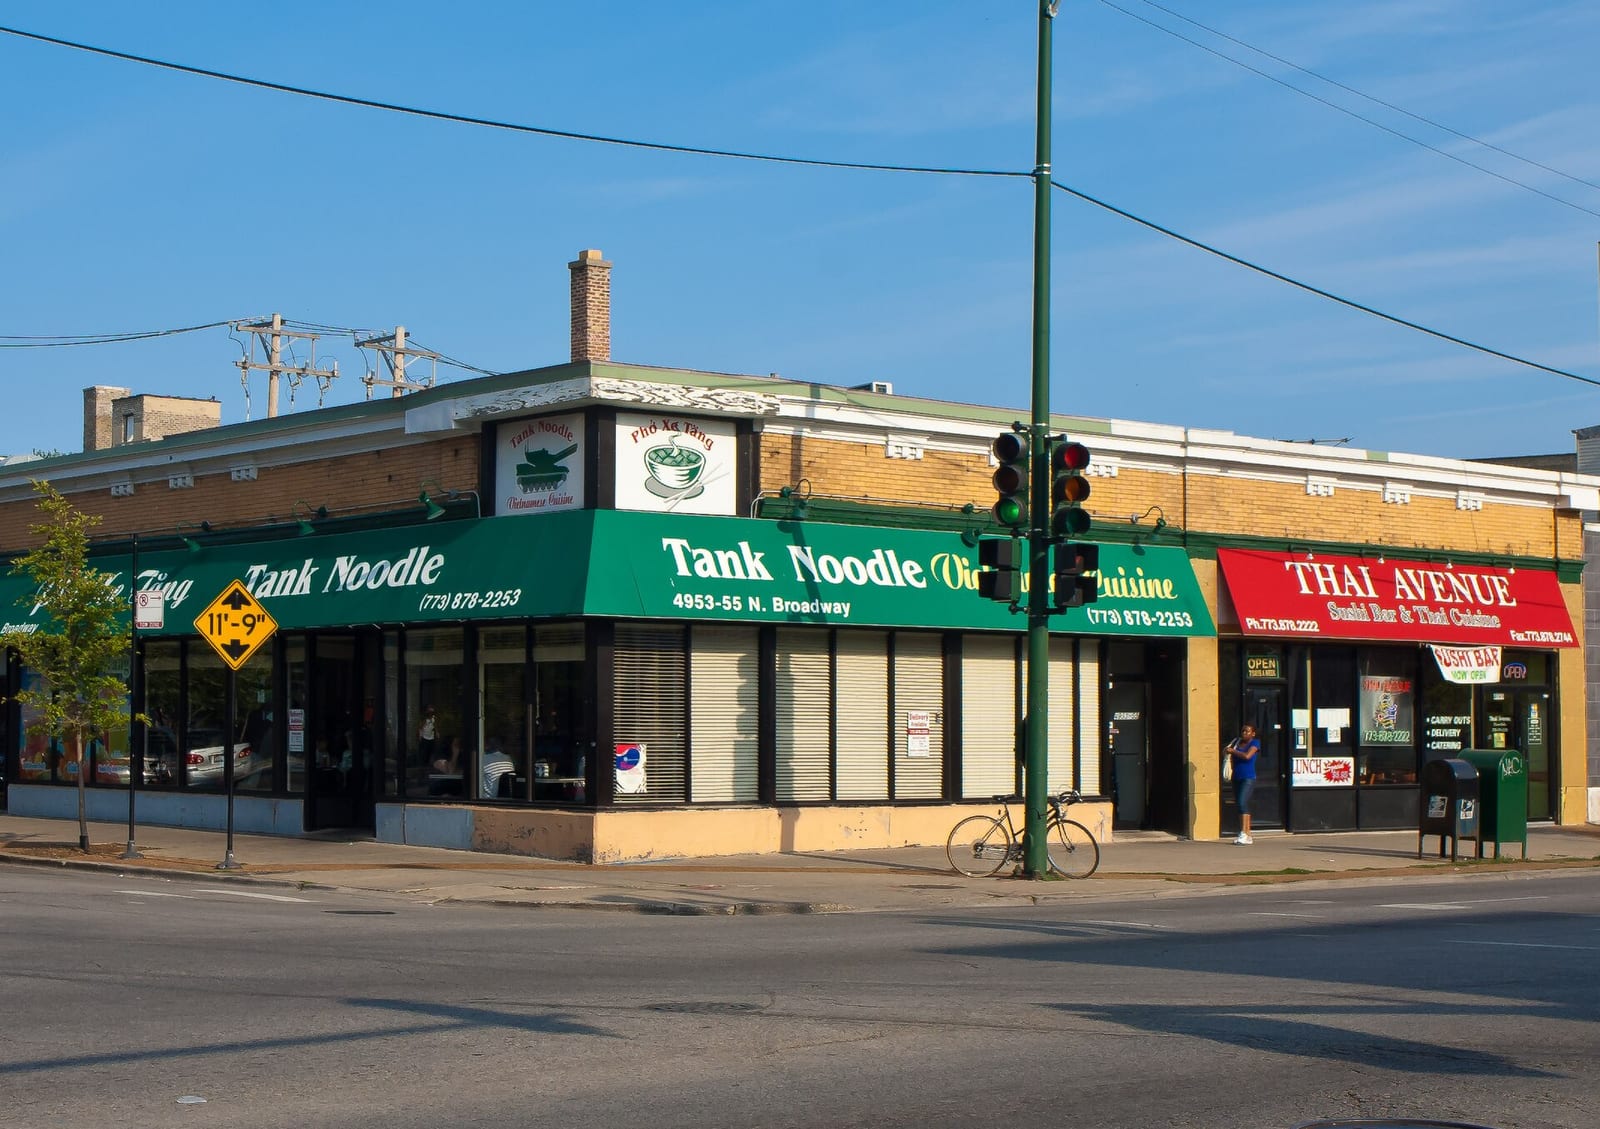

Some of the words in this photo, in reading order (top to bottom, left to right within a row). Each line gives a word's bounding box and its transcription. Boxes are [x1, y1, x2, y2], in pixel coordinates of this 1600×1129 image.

[510, 423, 536, 448] Tank
[537, 419, 574, 442] Noodle
[506, 496, 546, 510] Vietnamese
[547, 491, 575, 506] Cuisine
[244, 558, 319, 598] Tank
[322, 546, 445, 593] Noodle
[661, 537, 774, 581] Tank
[786, 544, 927, 589] Noodle
[1285, 561, 1379, 599] THAI
[1394, 567, 1517, 607] AVENUE
[419, 593, 449, 612] (773)
[450, 589, 521, 609] 878-2253
[672, 593, 742, 612] 4953-55
[748, 596, 767, 612] N.
[773, 597, 851, 618] Broadway
[1087, 607, 1122, 625] (773)
[1124, 609, 1193, 628] 878-2253
[1327, 601, 1370, 621] Sushi
[1369, 603, 1397, 623] Bar
[1399, 605, 1414, 623] &
[1412, 605, 1450, 625] Thai
[1450, 608, 1501, 628] Cuisine
[1247, 658, 1276, 669] OPEN
[1435, 648, 1472, 667] SUSHI
[1473, 647, 1499, 667] BAR
[1504, 664, 1526, 679] OPEN
[1431, 716, 1453, 725] CARRY
[1453, 716, 1471, 725] OUTS
[1431, 729, 1461, 737] DELIVERY
[1431, 741, 1462, 750] CATERING
